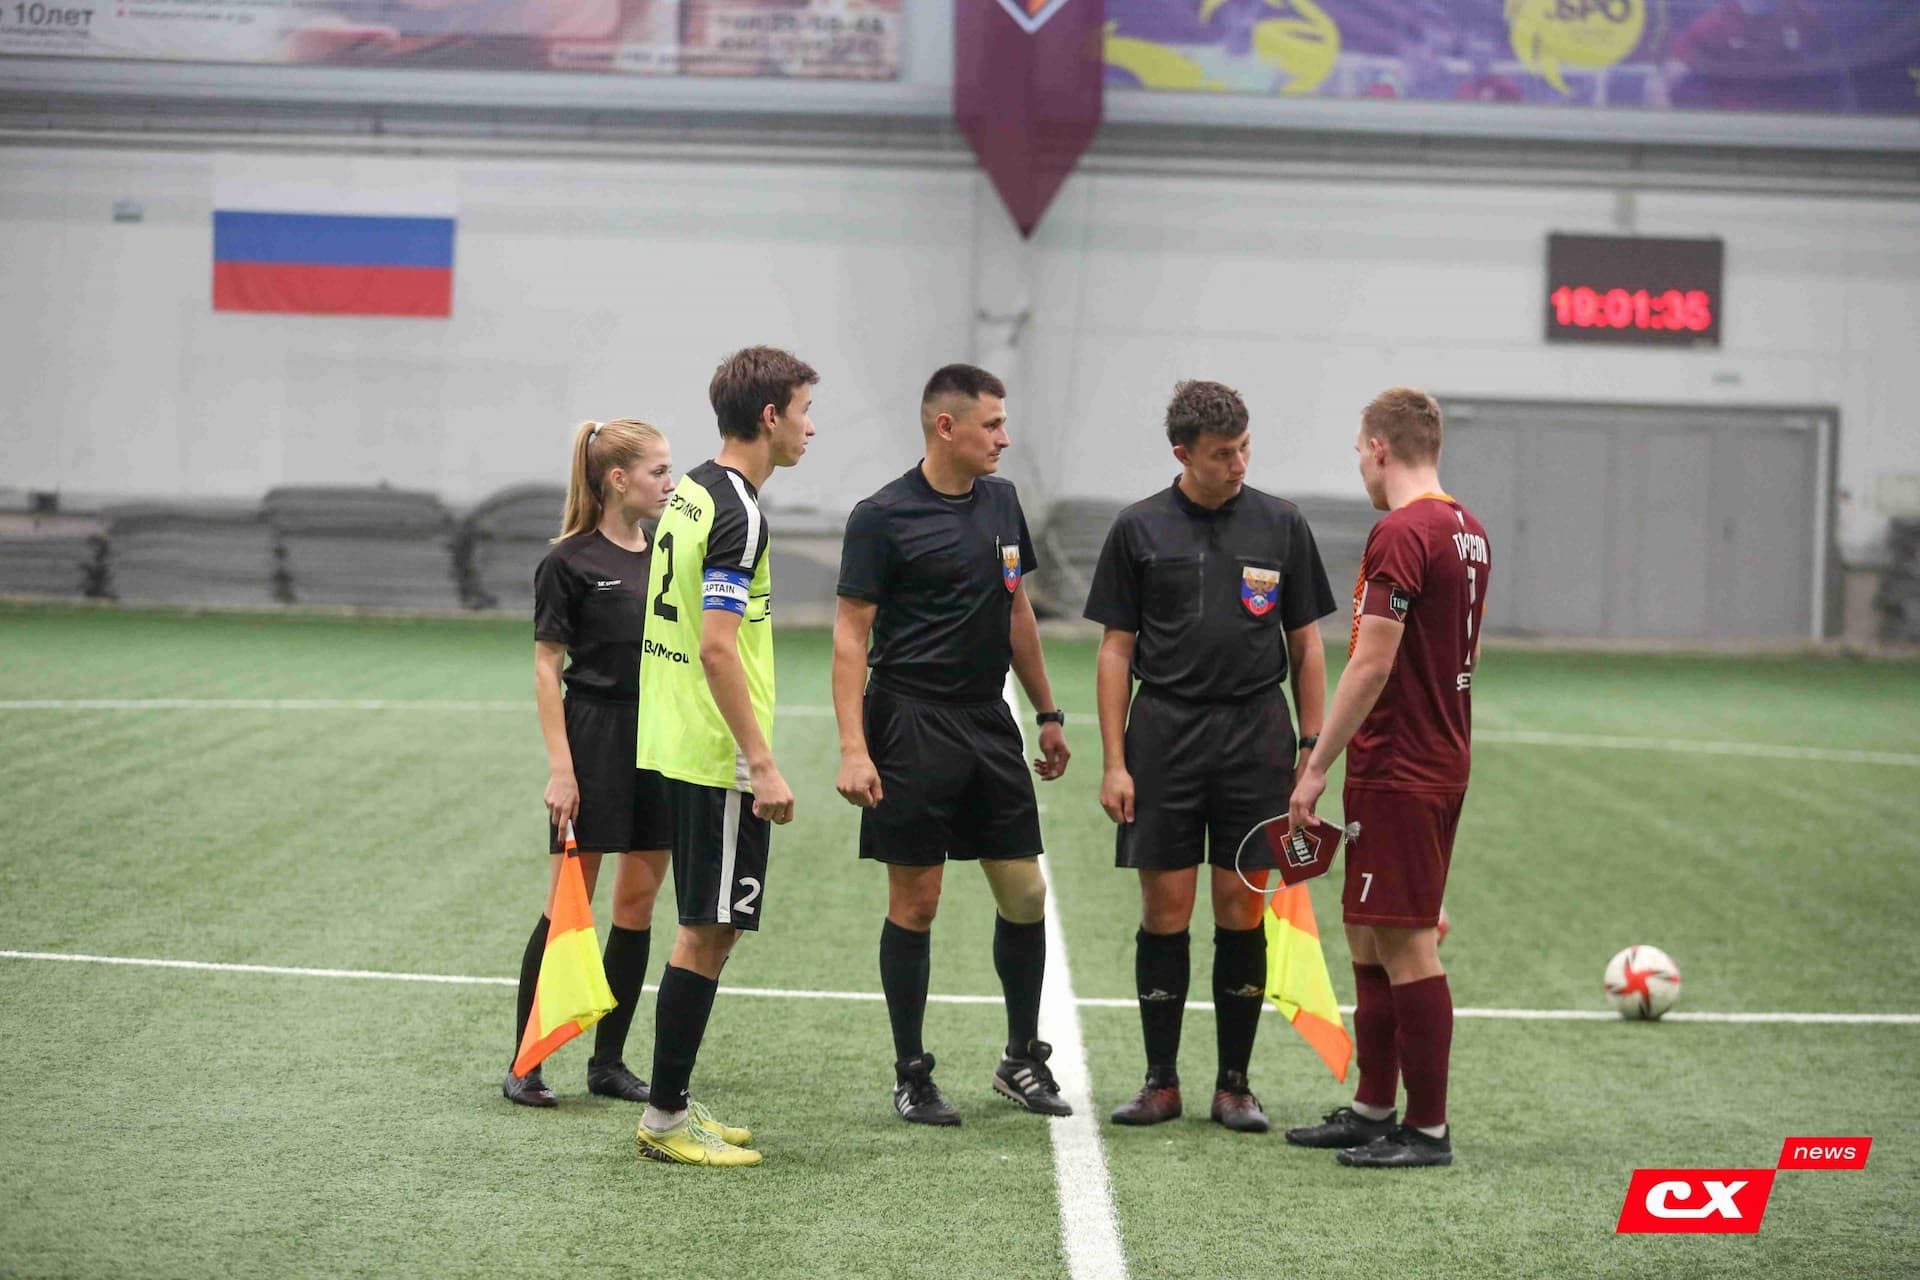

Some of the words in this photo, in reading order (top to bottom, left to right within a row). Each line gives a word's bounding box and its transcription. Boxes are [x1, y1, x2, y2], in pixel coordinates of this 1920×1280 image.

[653, 531, 678, 623] 2
[733, 876, 761, 915] 2
[1359, 872, 1373, 902] 7
